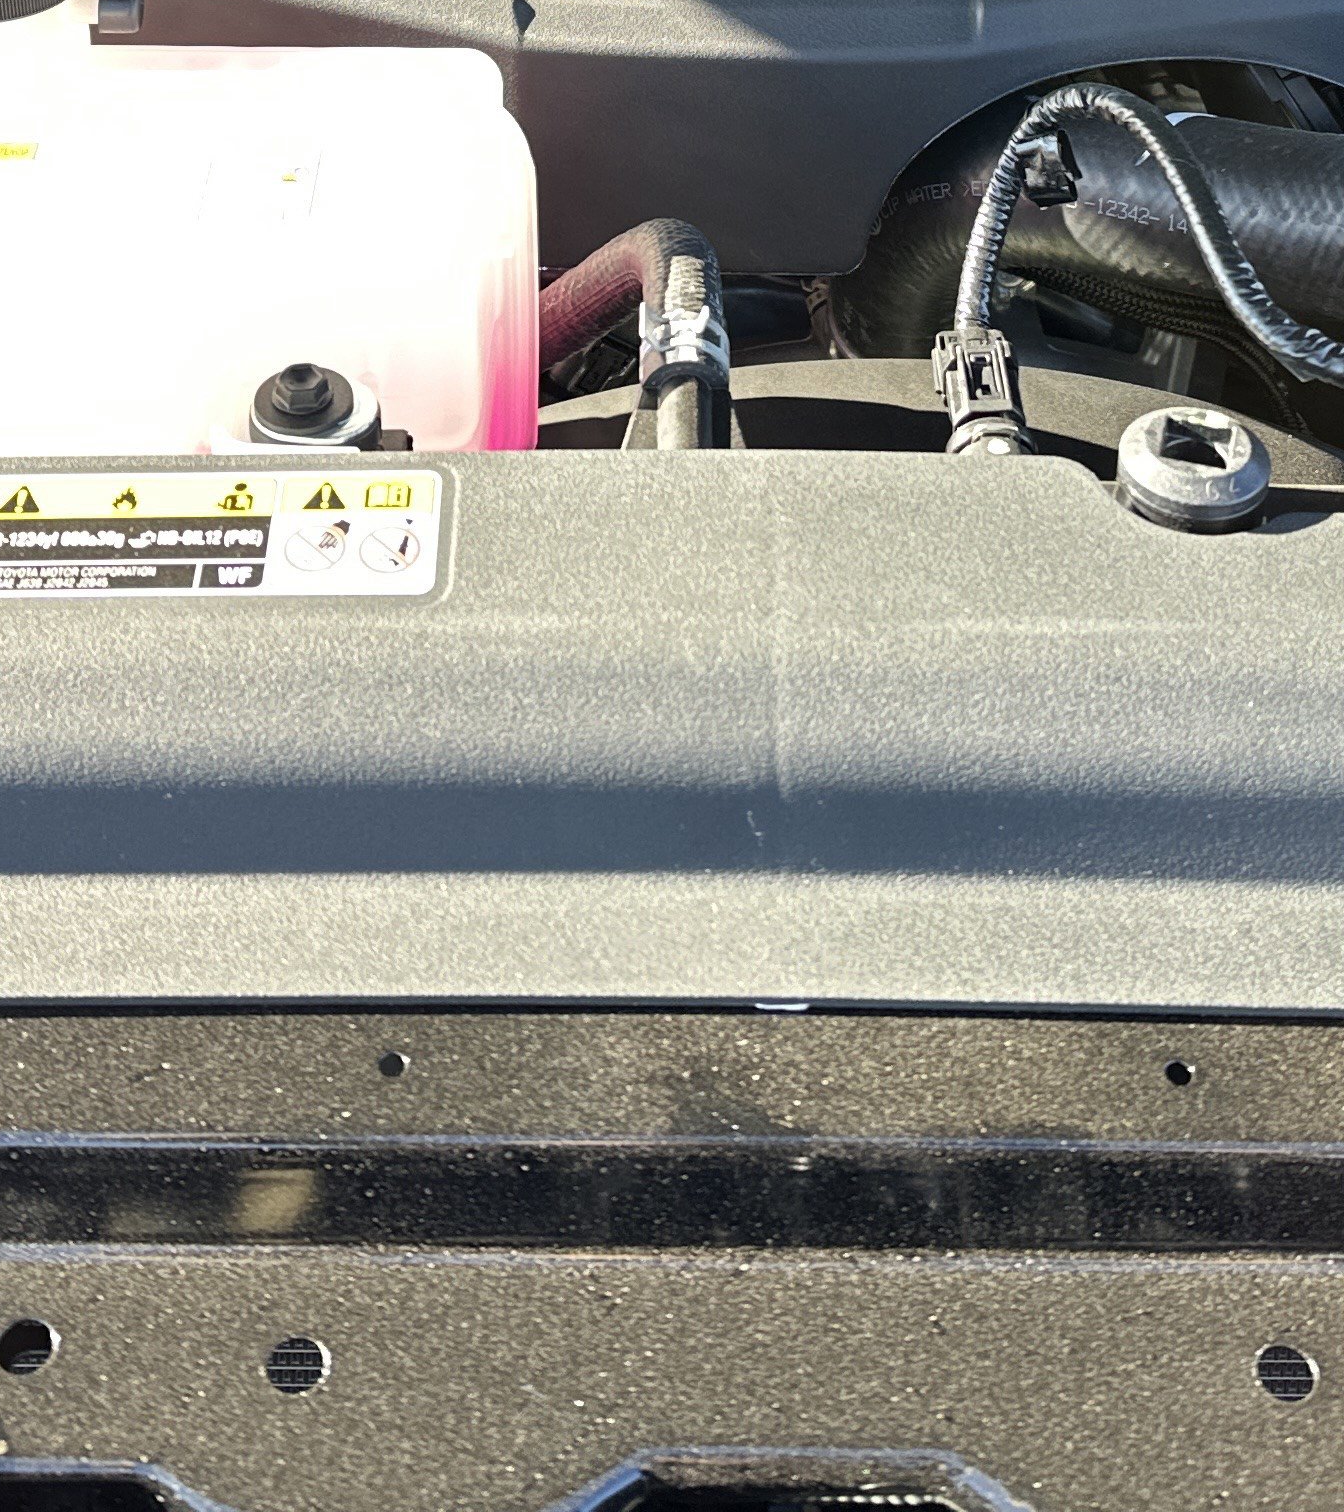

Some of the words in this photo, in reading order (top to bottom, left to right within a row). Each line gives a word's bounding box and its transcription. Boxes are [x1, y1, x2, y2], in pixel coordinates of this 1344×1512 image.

[906, 182, 954, 206] WATER
[39, 566, 80, 578] MOTOR
[80, 565, 157, 578] CORPORATION
[217, 565, 254, 586] WF
